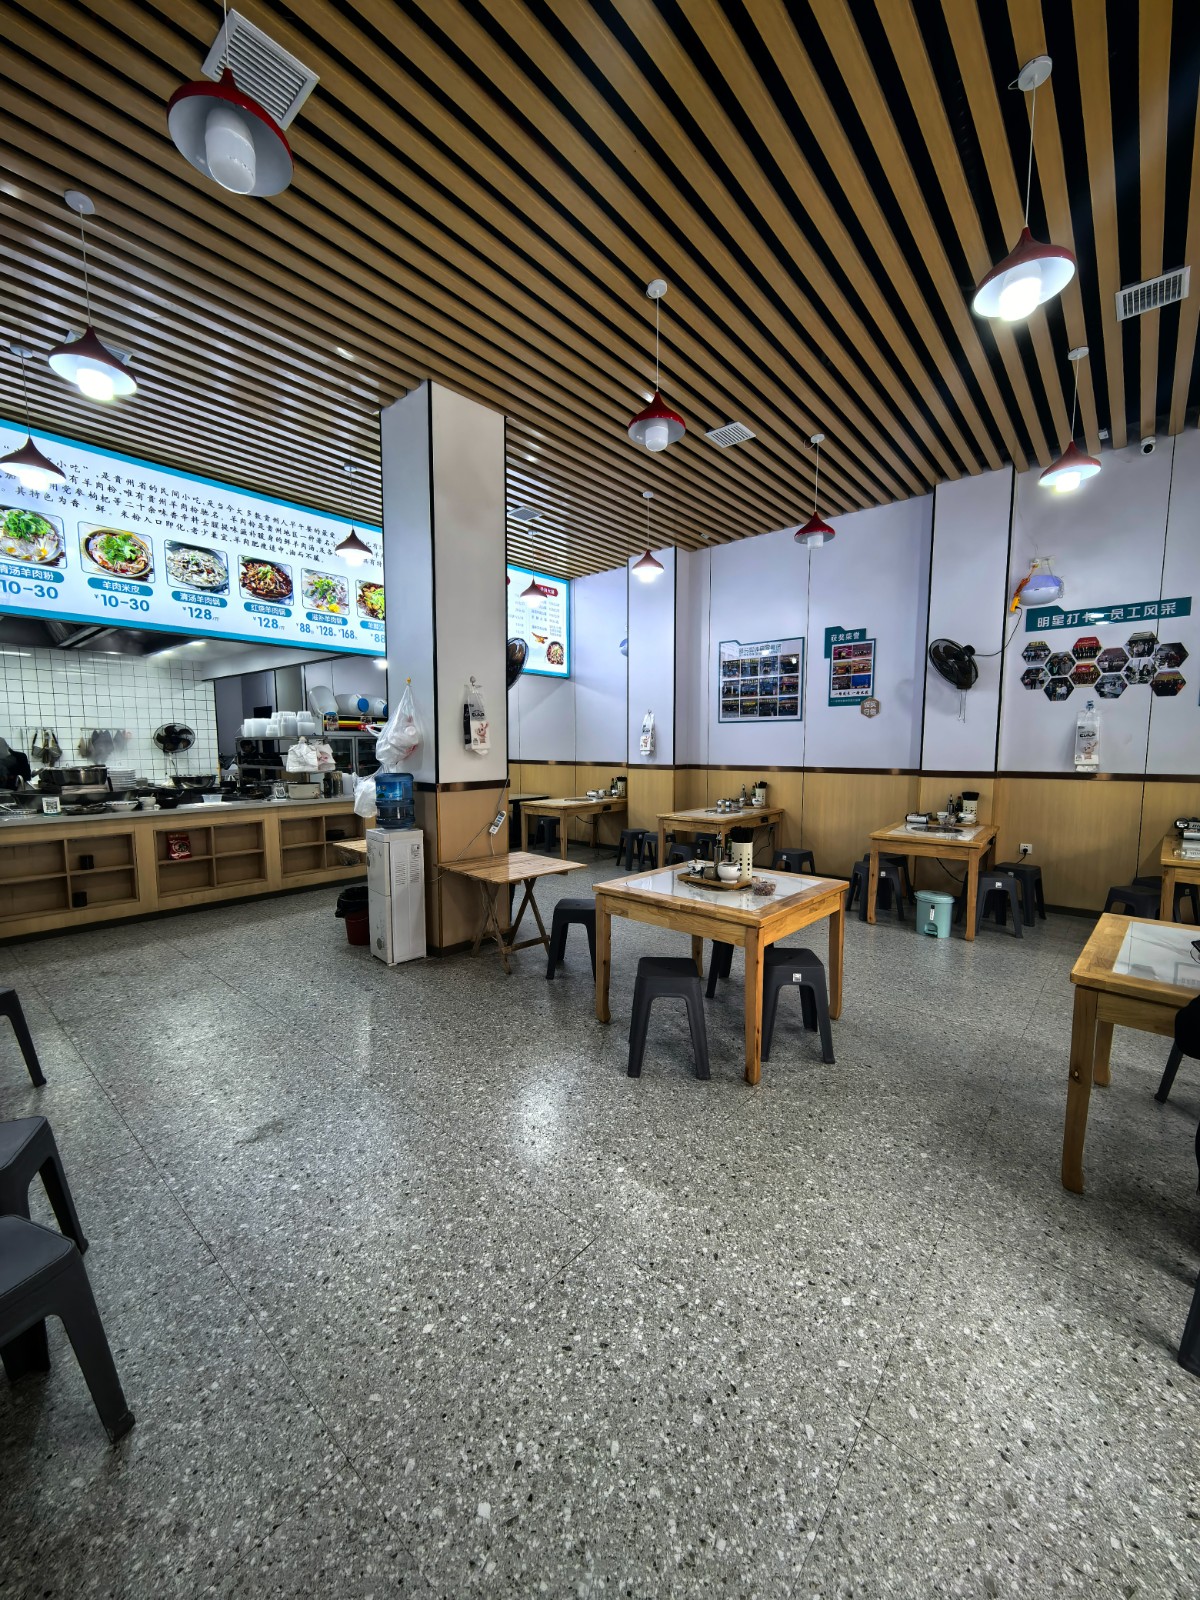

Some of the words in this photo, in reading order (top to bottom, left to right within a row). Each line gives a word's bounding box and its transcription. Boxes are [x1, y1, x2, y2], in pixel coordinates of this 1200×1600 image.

[102, 580, 140, 594] 羊肉米皮
[179, 592, 221, 607] 清汤羊肉锅
[251, 603, 286, 617] 红烧羊肉锅
[1037, 611, 1096, 629] 明星打卡
[1111, 601, 1177, 621] 员工风采
